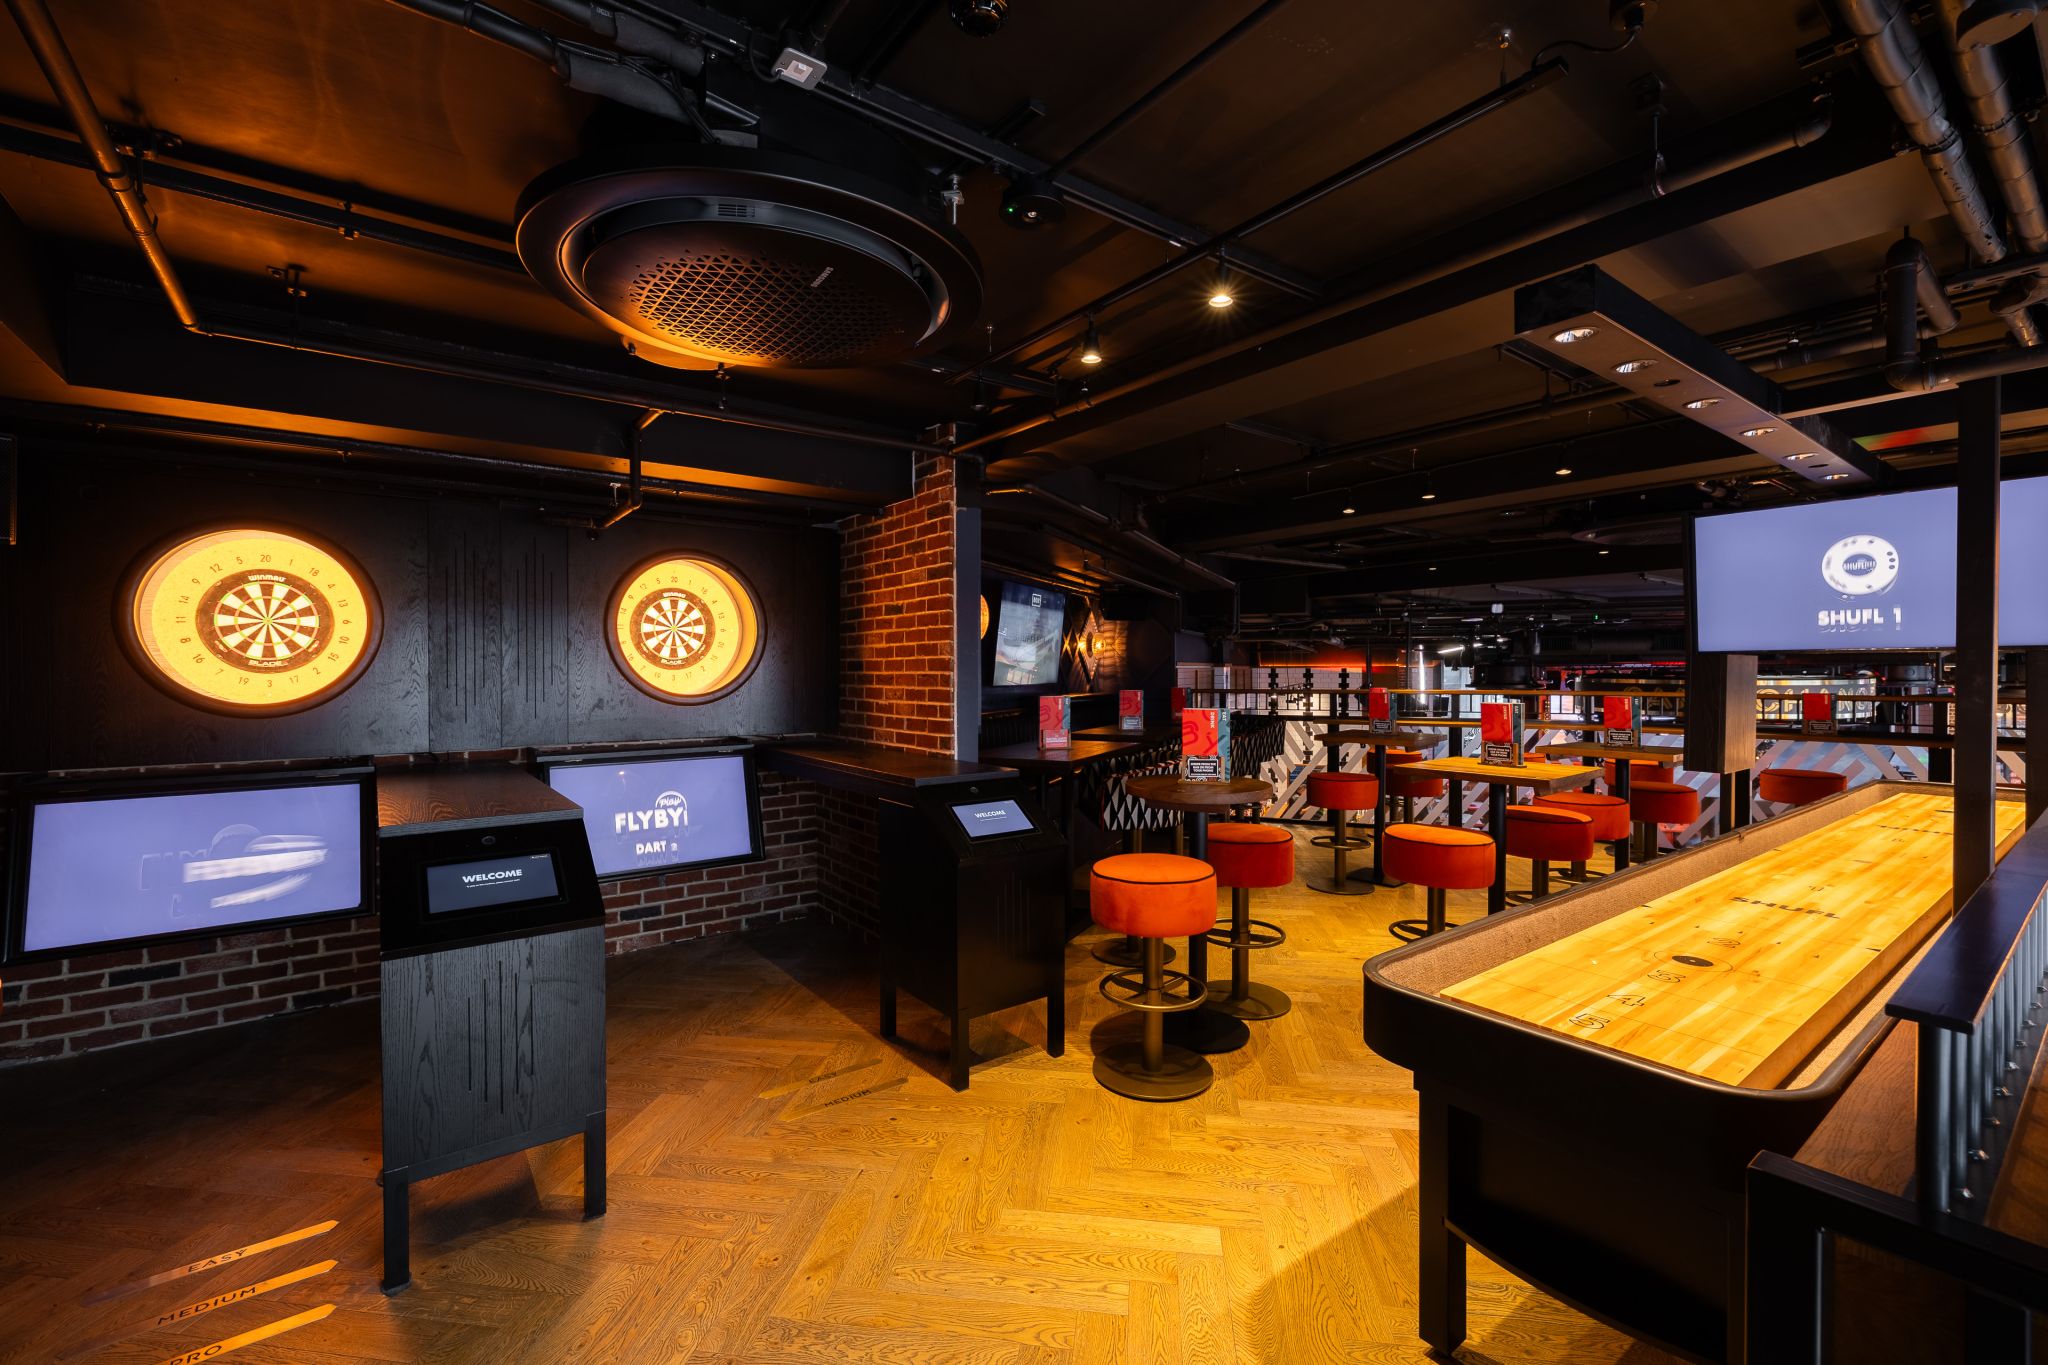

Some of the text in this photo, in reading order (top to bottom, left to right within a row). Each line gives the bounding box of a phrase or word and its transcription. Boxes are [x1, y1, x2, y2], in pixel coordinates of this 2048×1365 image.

[210, 563, 222, 573] 12
[308, 568, 320, 577] 18
[179, 595, 189, 604] 14
[338, 599, 348, 608] 13
[1818, 607, 1902, 626] SHUFL 1
[339, 636, 350, 645] 10
[192, 653, 203, 664] 16
[328, 652, 340, 662] 15
[238, 676, 249, 686] 19
[289, 676, 300, 684] 17
[615, 807, 684, 833] FLYBY
[974, 810, 1006, 818] WELCOME
[636, 840, 666, 855] DART
[462, 869, 522, 882] WELCOME
[1606, 994, 1646, 1006] 4
[1569, 1013, 1610, 1029] 5
[808, 1072, 837, 1084] EASY
[824, 1090, 872, 1108] MEDIUM
[188, 1248, 248, 1272] EASY
[158, 1286, 256, 1326] MEDIUM
[170, 1345, 222, 1365] PRO
